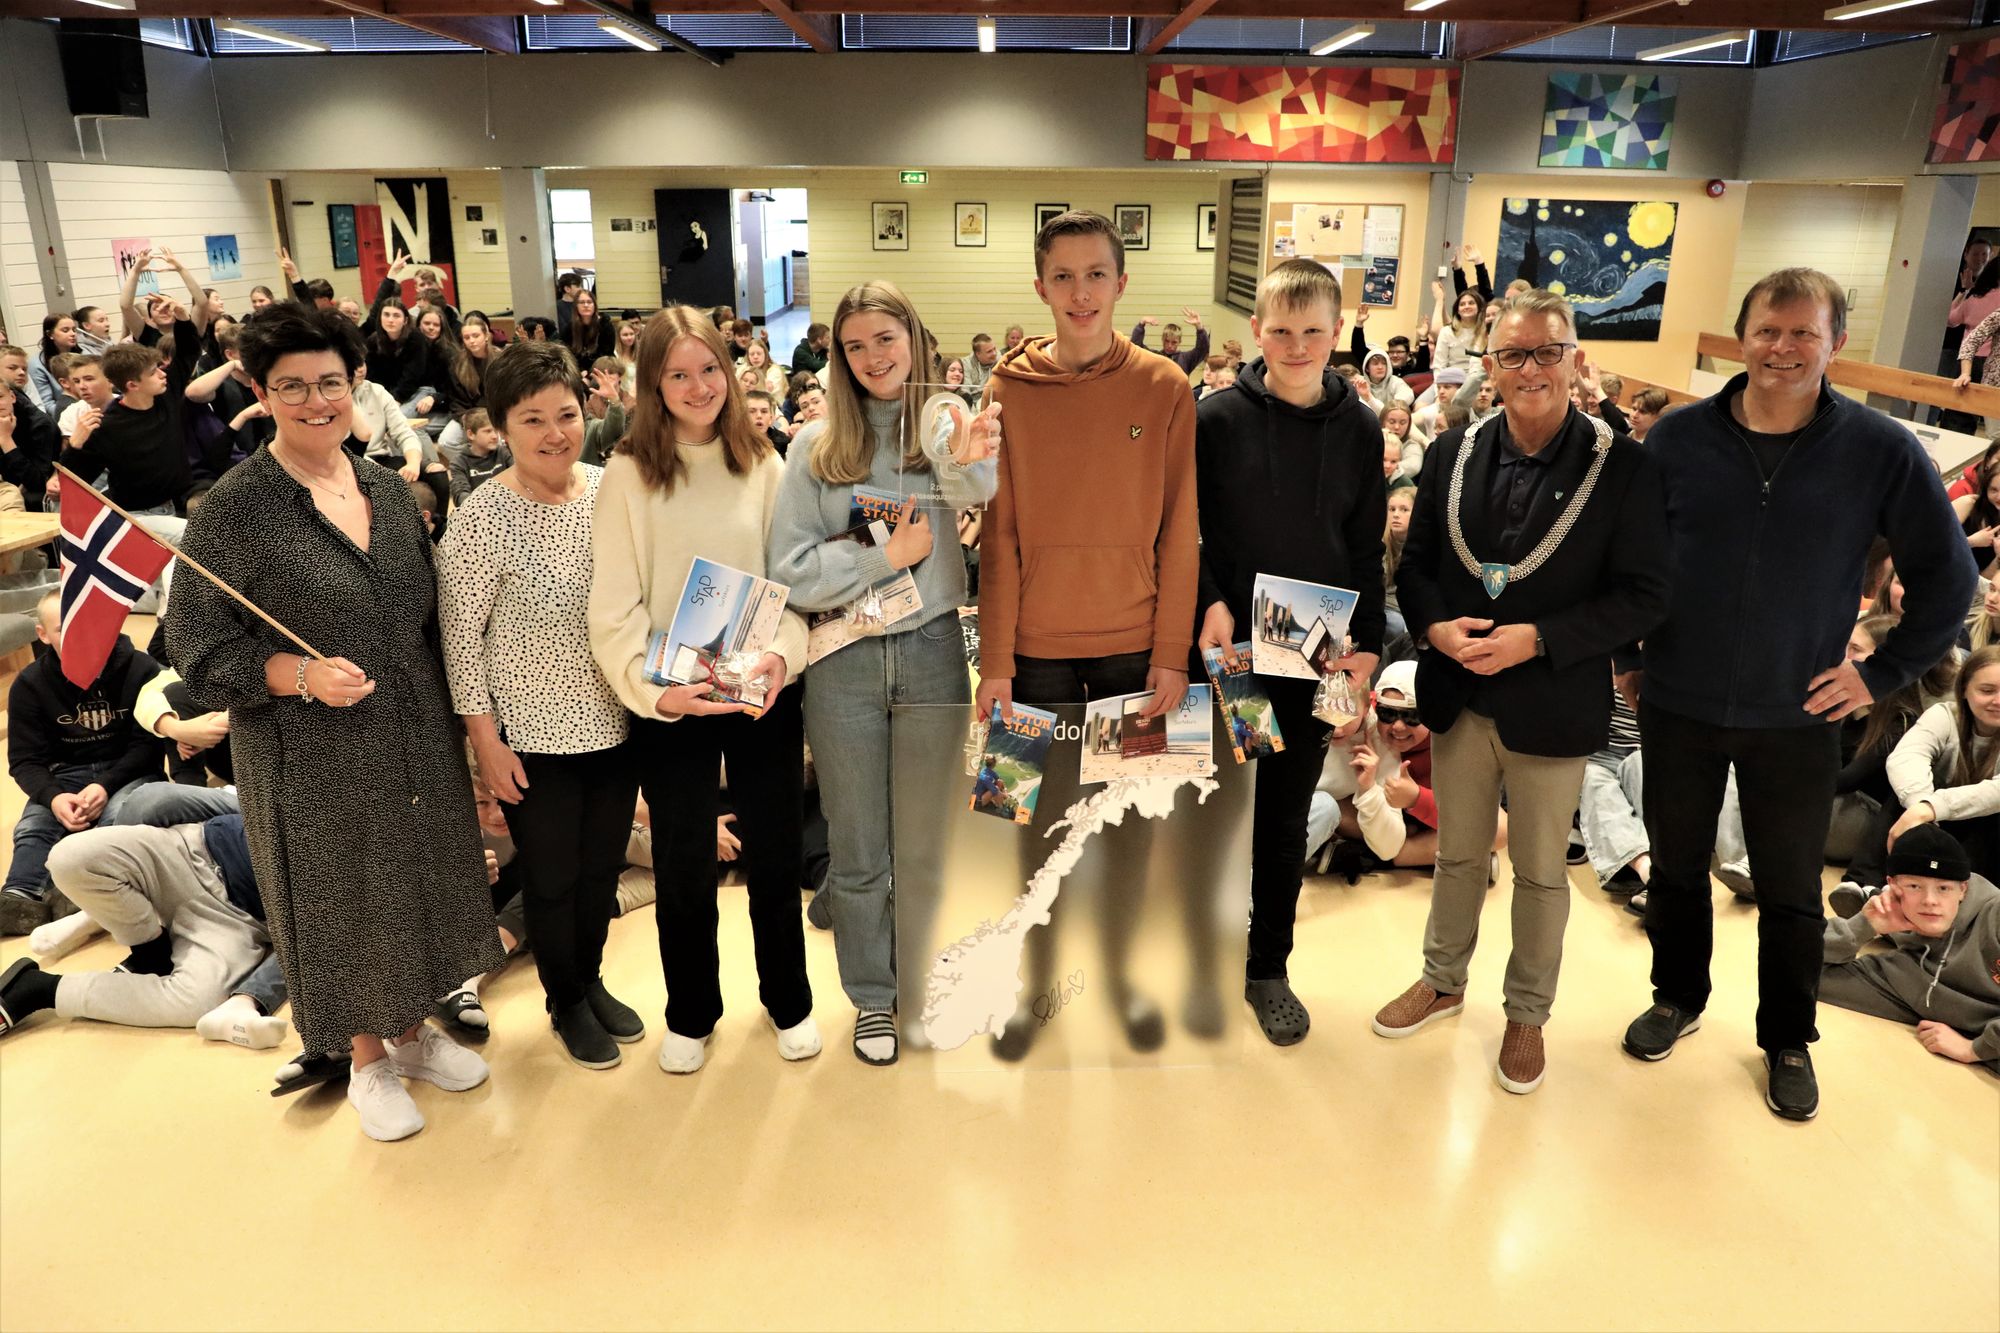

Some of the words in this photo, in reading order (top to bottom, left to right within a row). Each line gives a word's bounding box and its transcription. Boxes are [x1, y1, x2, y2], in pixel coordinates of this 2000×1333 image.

[856, 496, 903, 512] OPPTU
[863, 507, 900, 523] STAD
[691, 575, 717, 606] STAD
[1320, 595, 1344, 616] STAD
